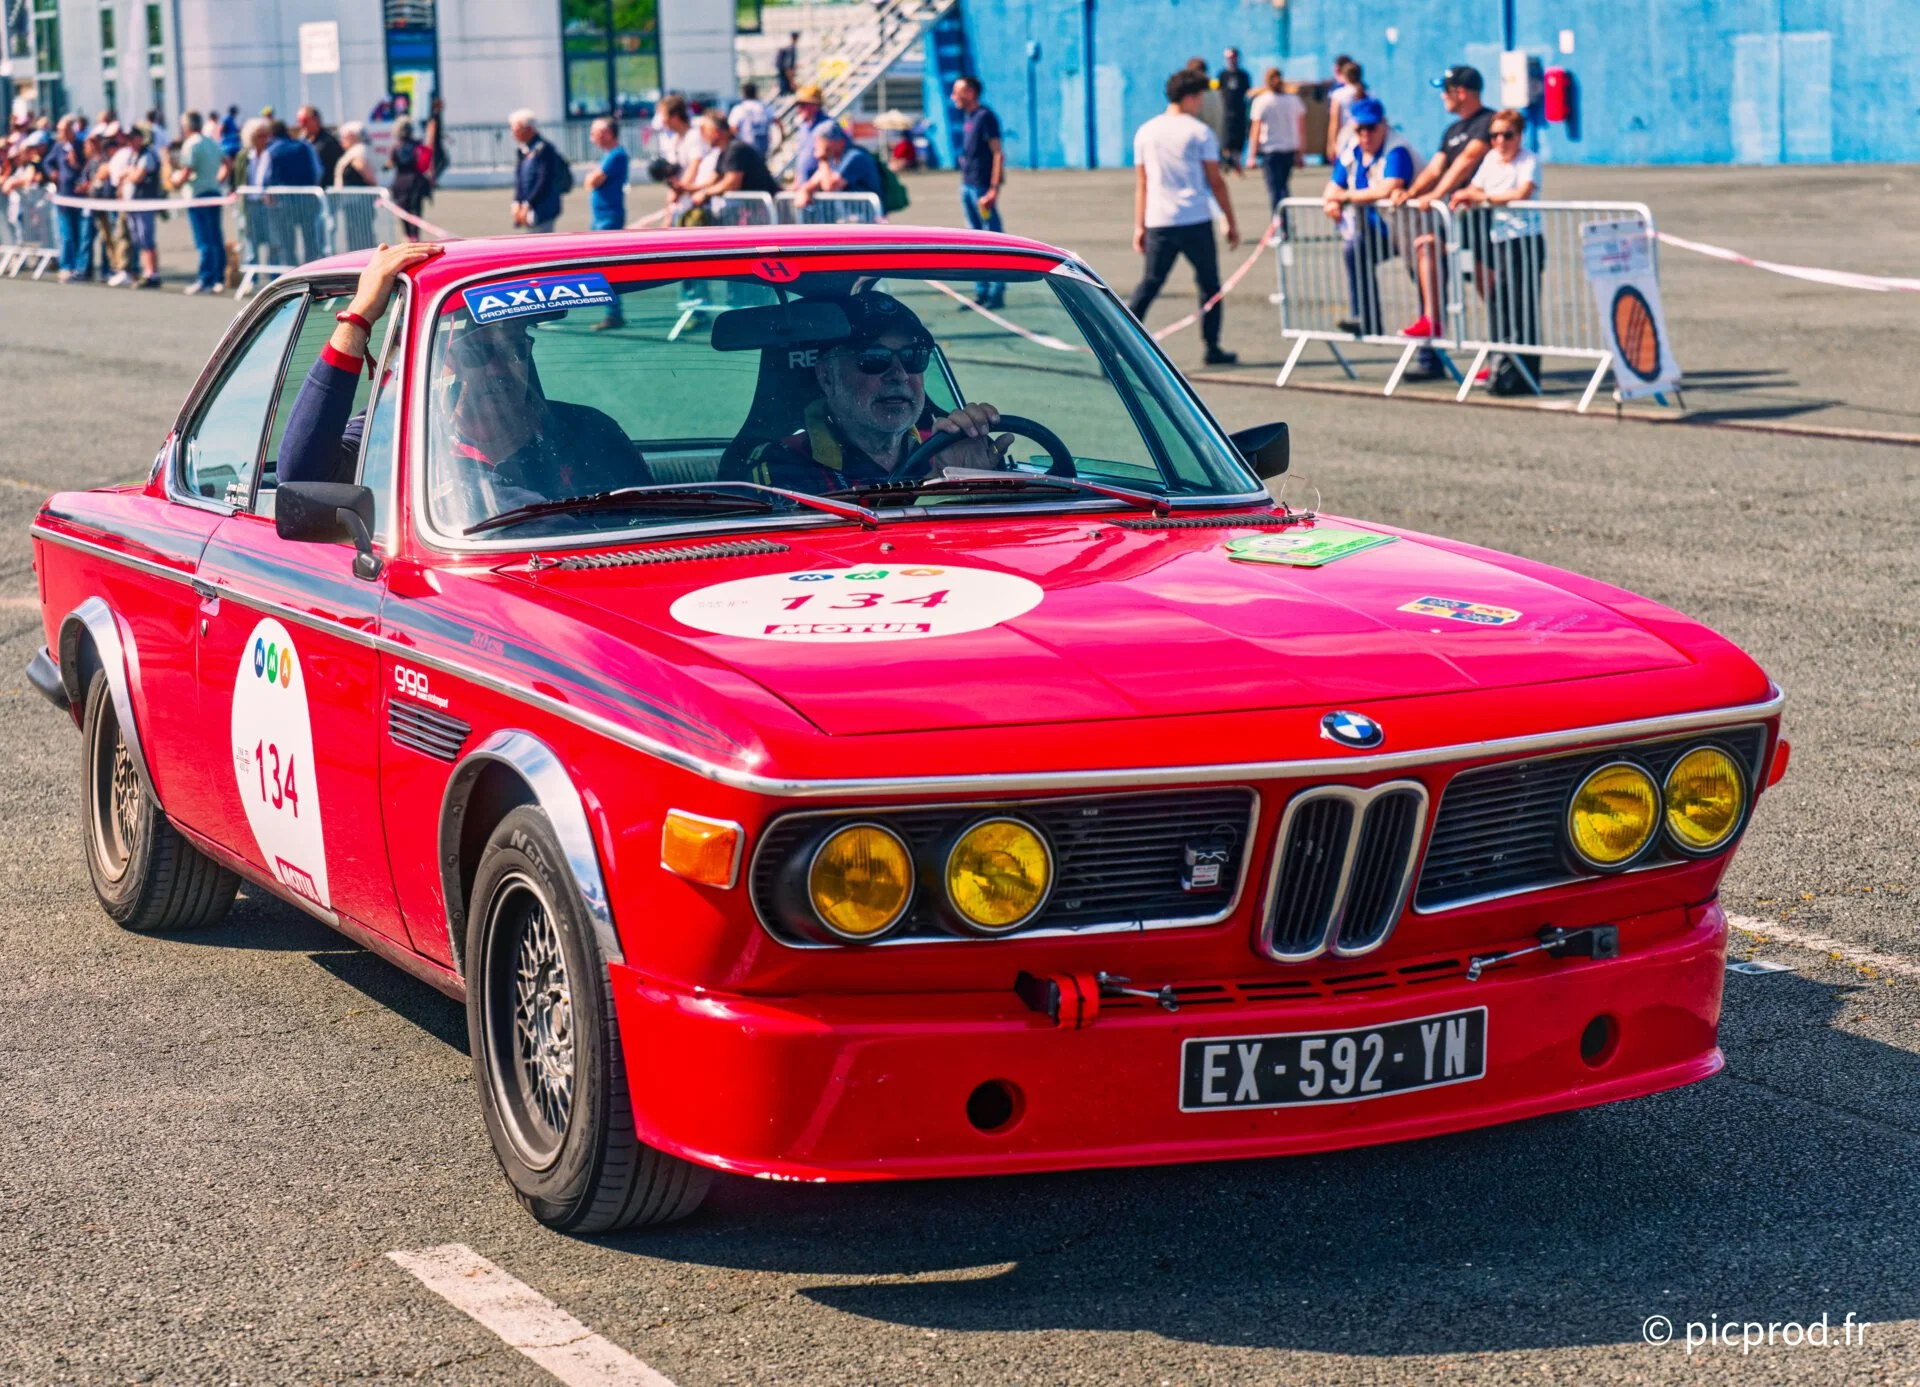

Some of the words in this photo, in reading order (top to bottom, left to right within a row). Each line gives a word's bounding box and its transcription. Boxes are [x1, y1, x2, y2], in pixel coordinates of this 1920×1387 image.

[760, 261, 791, 278] H
[477, 283, 609, 314] AXIAL
[480, 303, 546, 320] PROFESSION
[547, 296, 613, 308] CARROSSIER
[788, 349, 819, 369] RE
[780, 589, 951, 611] 134
[769, 623, 924, 634] MOTUL
[255, 739, 299, 818] 134
